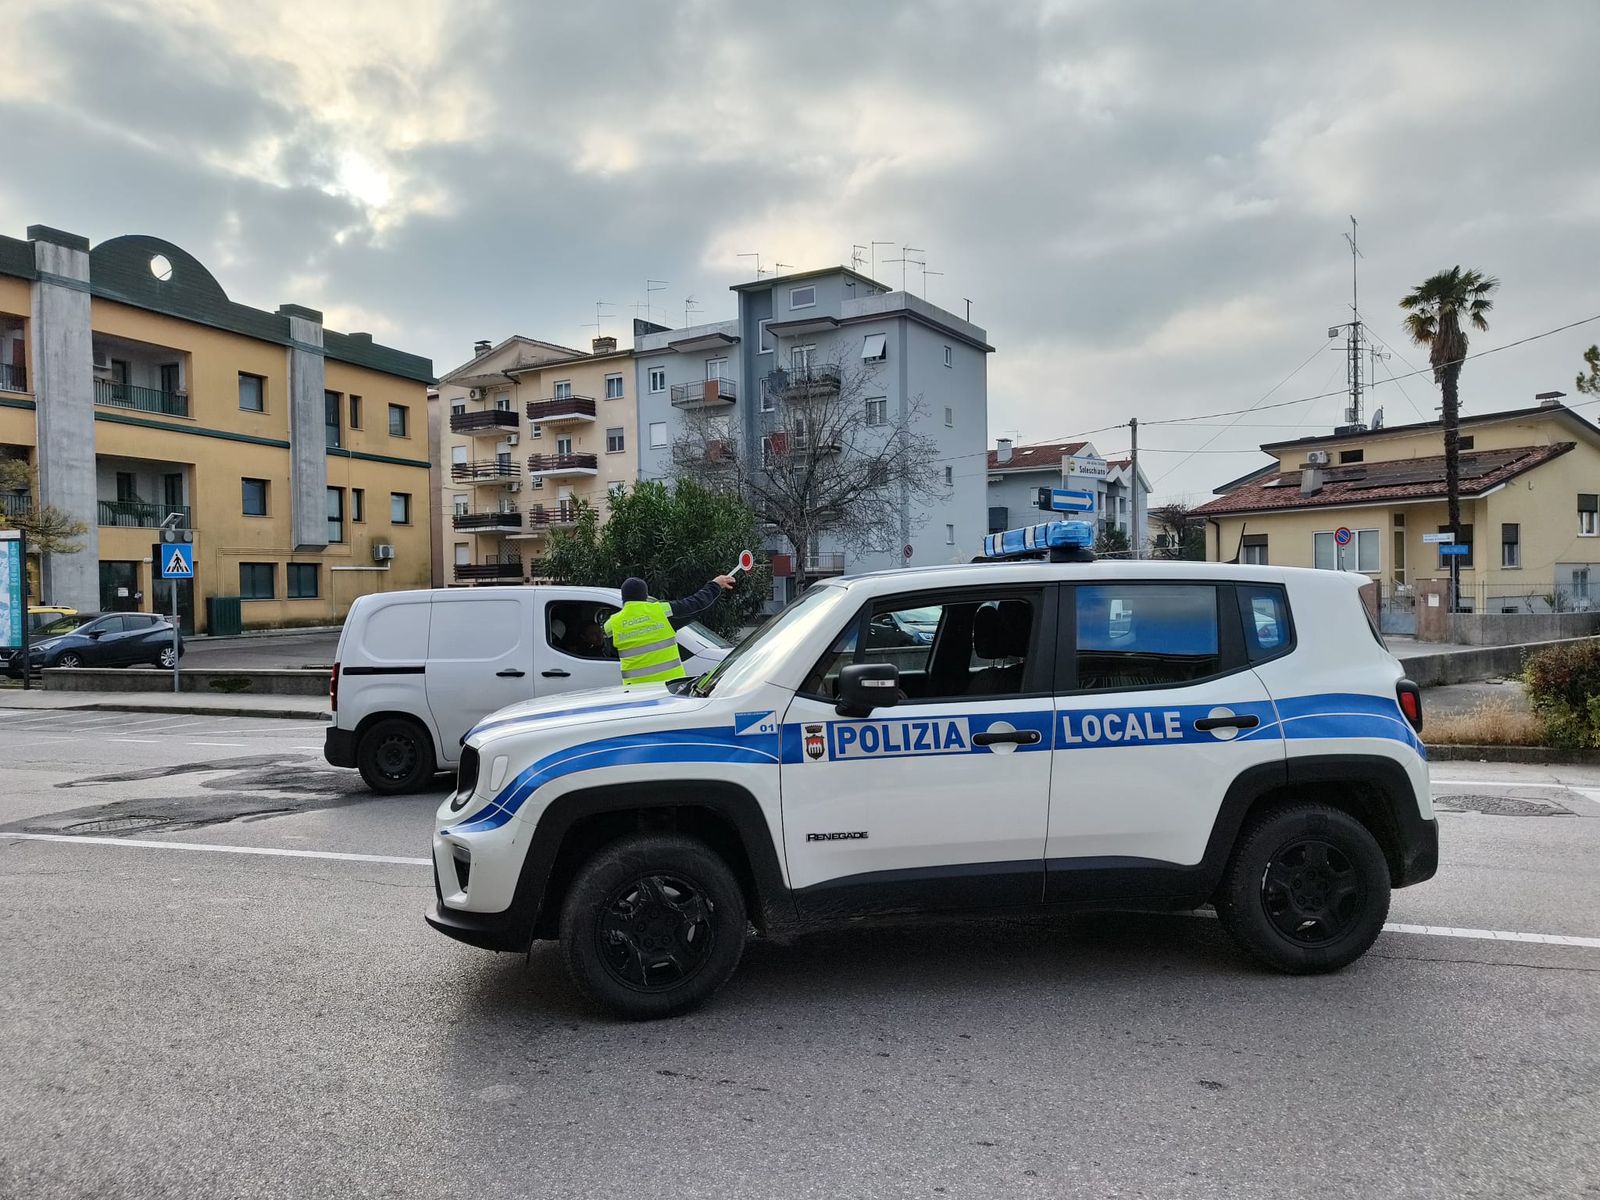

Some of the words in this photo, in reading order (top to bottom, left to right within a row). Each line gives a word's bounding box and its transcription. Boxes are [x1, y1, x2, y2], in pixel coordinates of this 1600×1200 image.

[760, 723, 774, 732] 01
[837, 721, 966, 754] POLIZIA
[1062, 711, 1183, 743] LOCALE
[806, 831, 868, 842] RENEGADE
